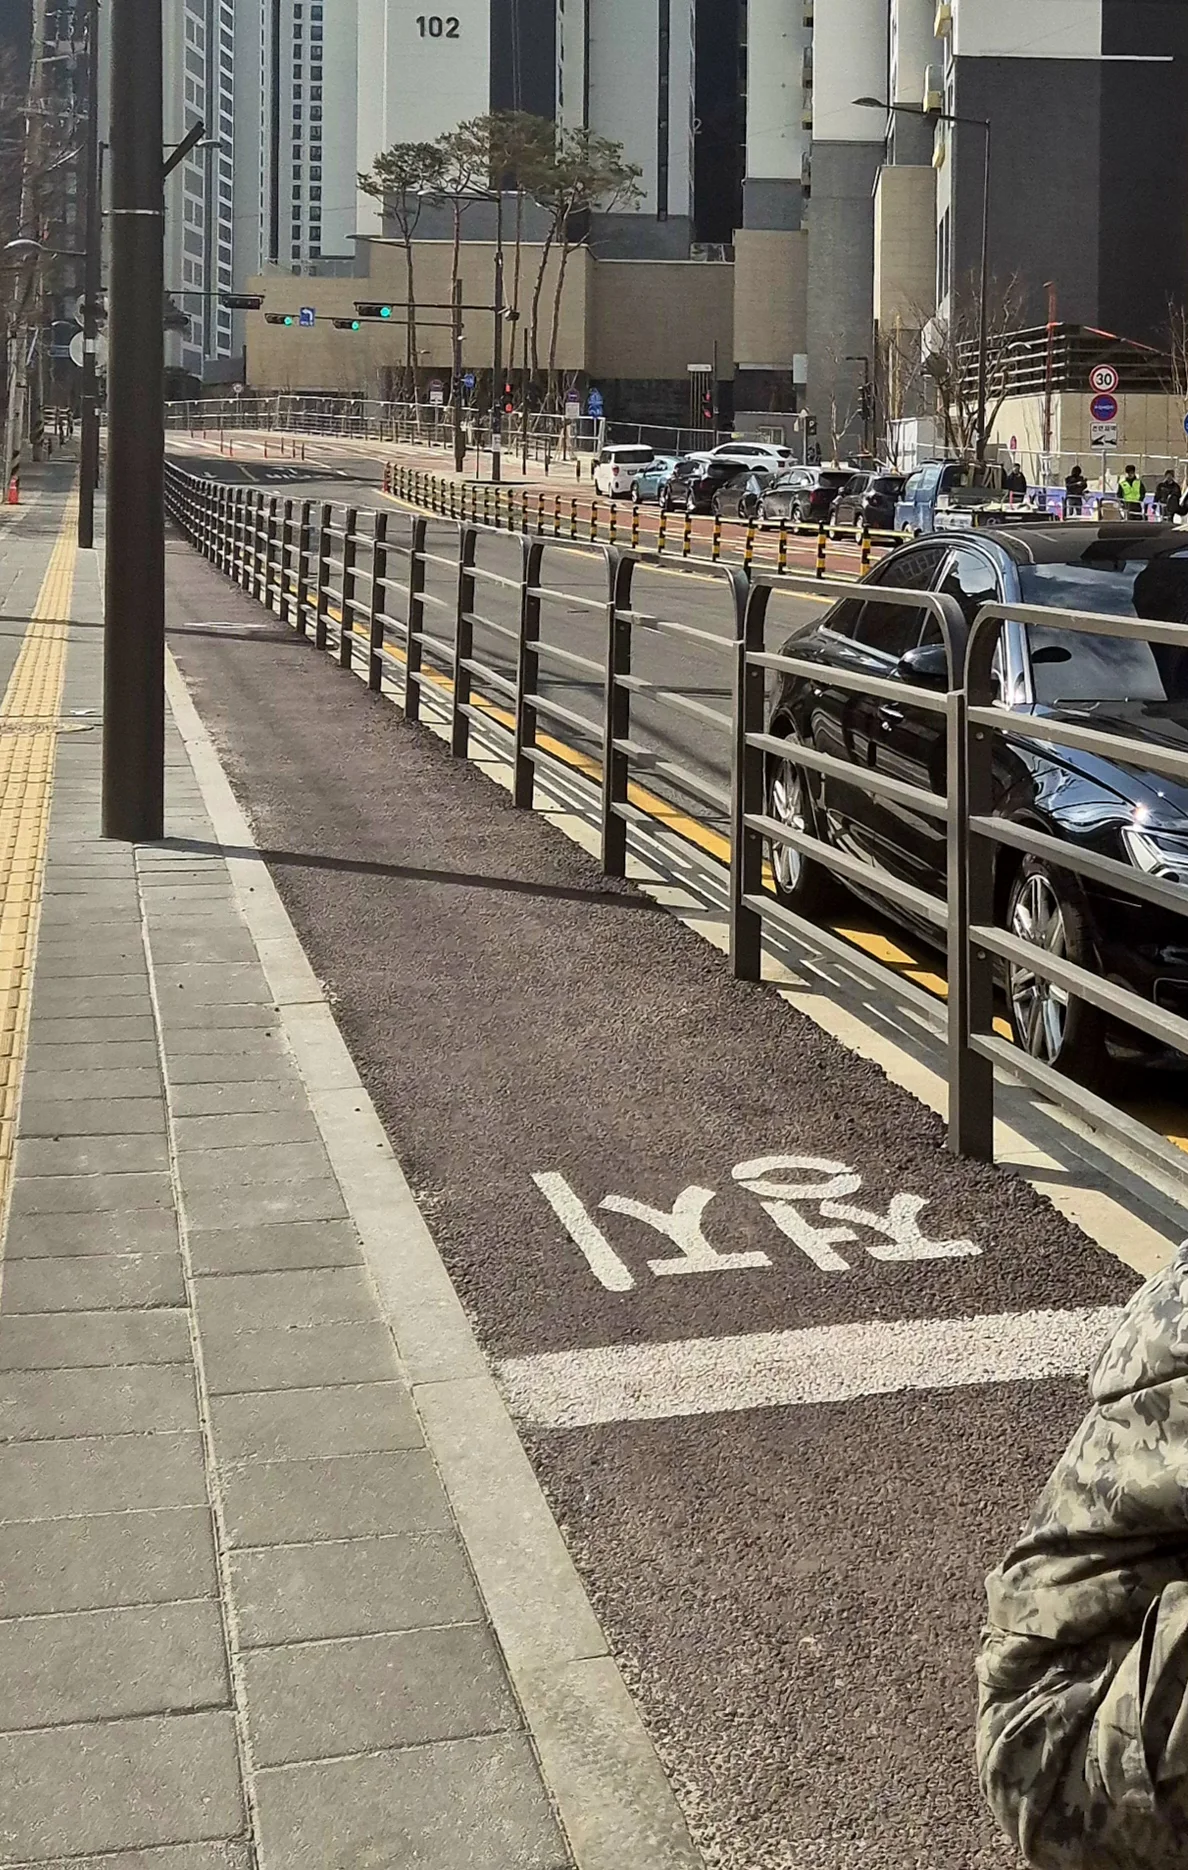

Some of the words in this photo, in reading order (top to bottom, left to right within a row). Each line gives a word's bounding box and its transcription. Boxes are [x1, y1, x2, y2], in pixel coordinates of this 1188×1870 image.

[416, 16, 460, 39] 102
[1096, 373, 1112, 386] 30
[530, 1155, 984, 1293] 정지
